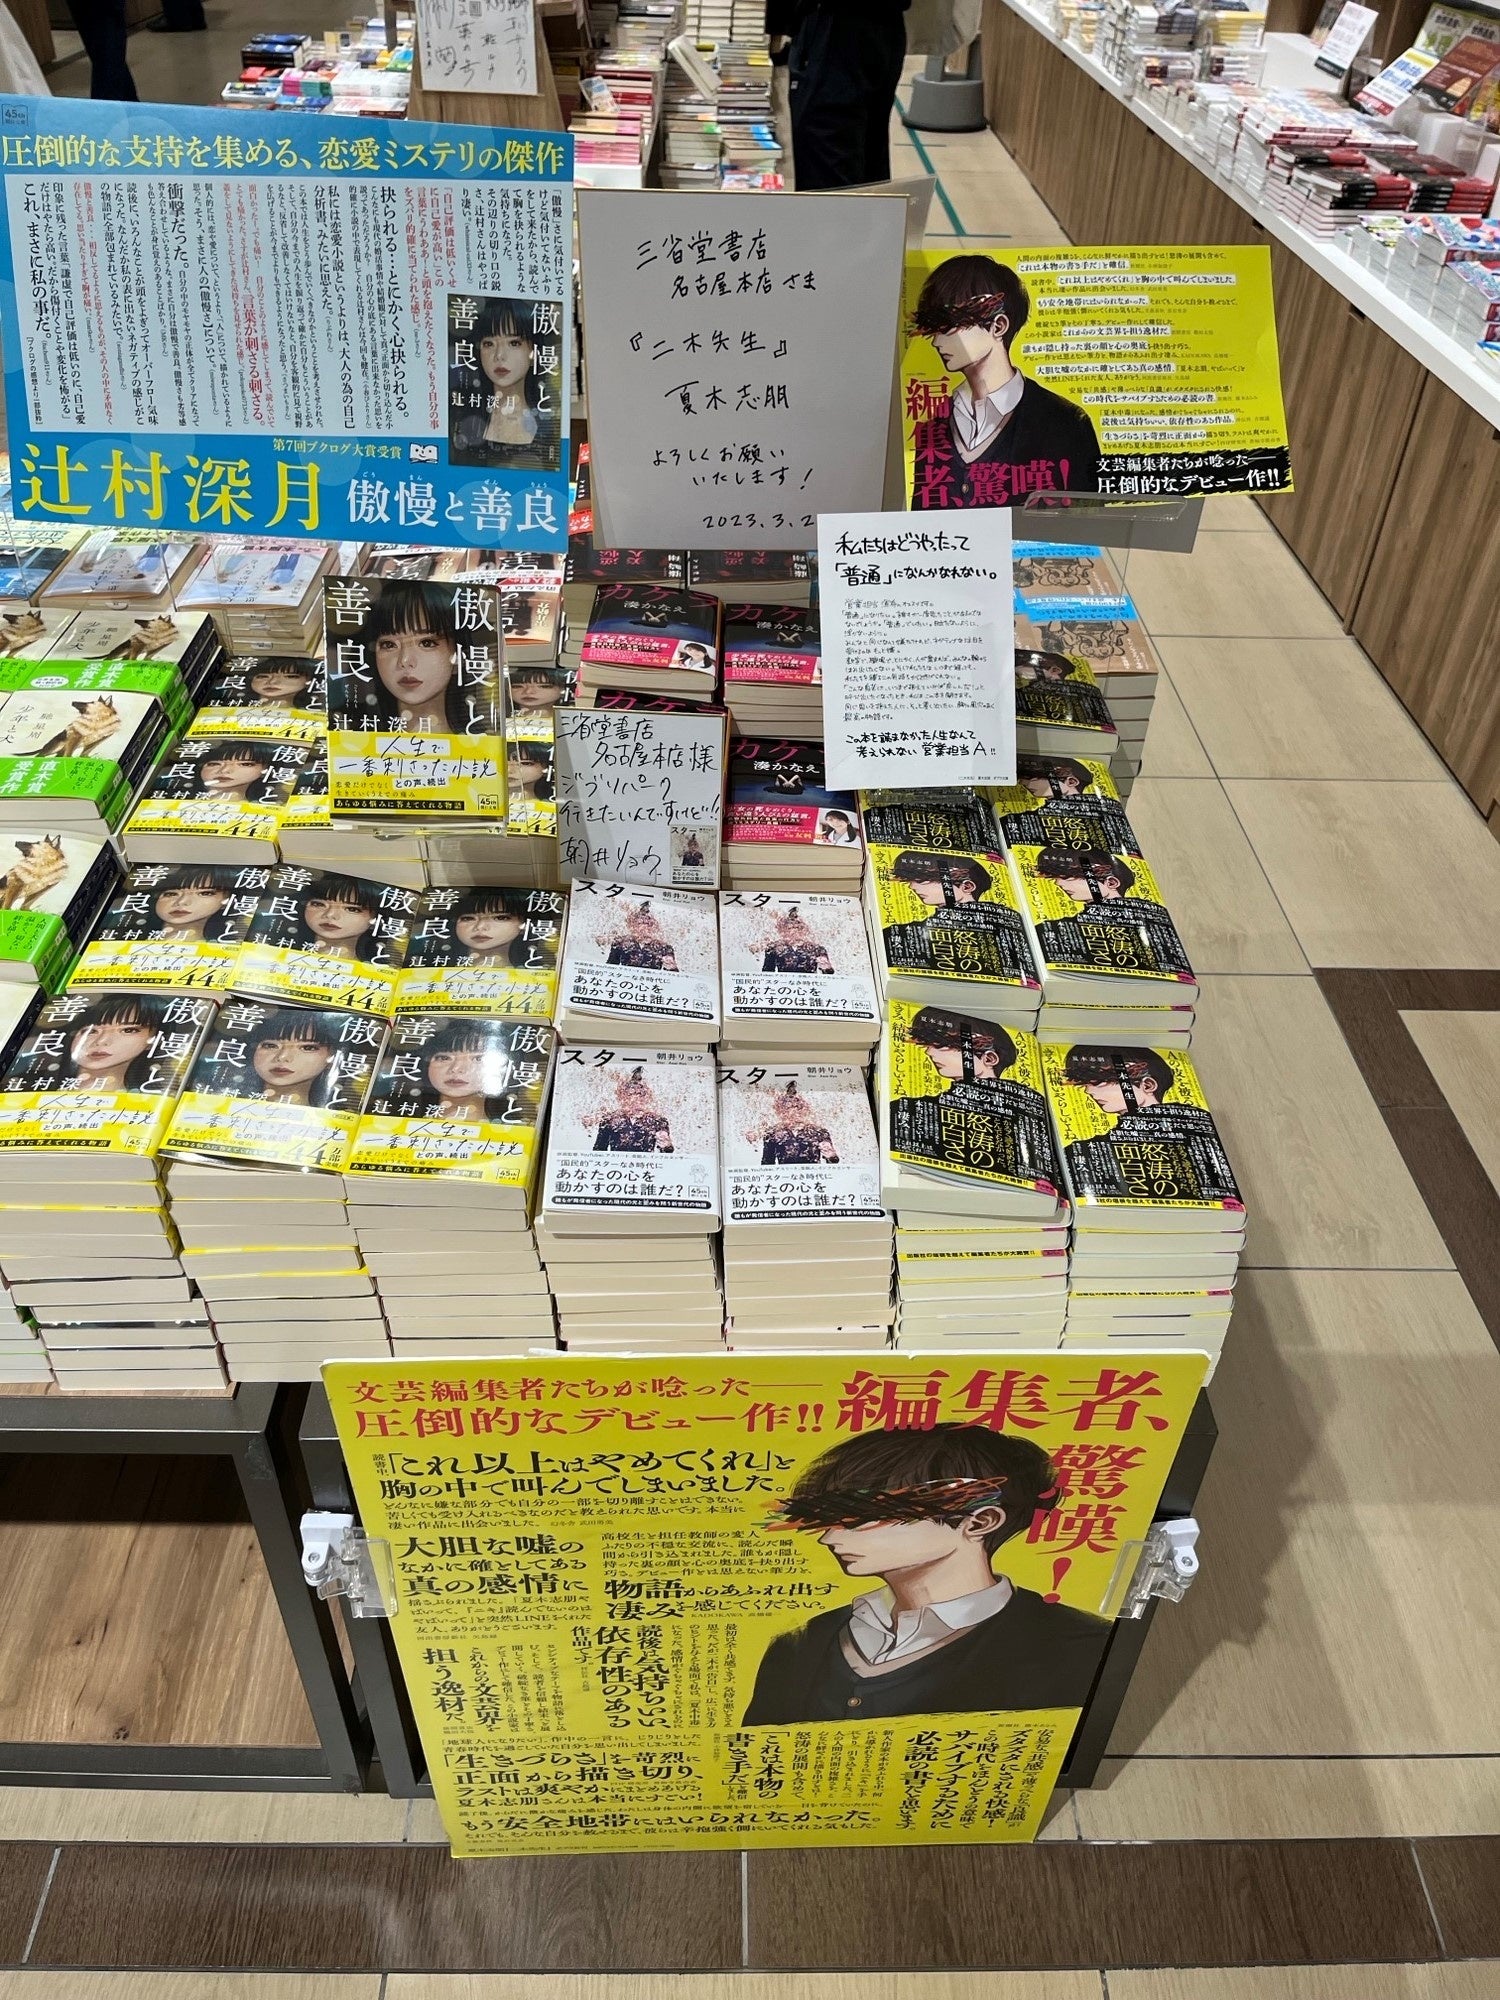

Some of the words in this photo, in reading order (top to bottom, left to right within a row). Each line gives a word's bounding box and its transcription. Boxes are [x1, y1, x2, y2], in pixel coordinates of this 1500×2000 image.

[2, 134, 565, 176] 圧倒的な支持を集める、恋愛ミステリの傑作
[430, 187, 444, 287] に自己愛が高い」この
[443, 187, 457, 288] 「自己評価は低いくせ
[500, 188, 513, 261] 気持ちになった。
[314, 185, 334, 315] 分析書、みたいに思えた。
[475, 188, 488, 290] さ、辻村さんはやっぱ
[487, 188, 501, 291] その辺りの切り口の鋭
[512, 189, 526, 294] て胸を抉られるような
[526, 189, 539, 294] をして来たから、読んで
[539, 189, 552, 295] けど気付いてないふり
[552, 189, 564, 295] 「傲慢」さに気付いてる
[636, 229, 769, 270] 三省堂書店
[24, 183, 52, 339] これ、まさに私の事だ。
[100, 182, 124, 341] の物語に全部包まれているみたいで。
[671, 267, 817, 299] 名古屋本店さま
[40, 182, 71, 420] だけはやたら高い。だから傷付くことや変化を怖がる」
[53, 182, 86, 424] 印象に残った言葉「謙虚で自己評価は低いのに、自己愛
[114, 182, 144, 425] になった。なんだか私の表に出ないネガティブの感じがこ
[126, 182, 159, 425] 読後に、いろんなことが頭をよぎってオーバーフロー気味
[328, 185, 355, 428] 私には恋愛小説というよりは、大人の為の自己
[449, 298, 479, 371] 善良
[630, 330, 788, 360] 『二木先生』
[529, 303, 560, 413] 傲慢と
[665, 381, 790, 415] 夏木志朋
[273, 438, 402, 460] 第7回ブクログ大賞受賞
[652, 443, 785, 466] よろしくお願い
[906, 376, 963, 508] 編集者、
[20, 443, 320, 531] 辻村深月
[347, 478, 559, 534] 傲慢と善良
[968, 459, 1072, 507] 驚嘆!
[834, 531, 971, 556] 私たちはどうやったって
[834, 563, 998, 586] 「普通」になんかなれない。
[623, 600, 688, 615] 湊かなえ
[326, 581, 373, 684] 善良
[755, 621, 818, 633] 湊かなえ
[74, 663, 104, 689] 受賞作
[99, 662, 127, 688] 直木賞
[217, 657, 258, 690] 善良
[450, 587, 496, 737] 傲慢と
[333, 713, 433, 732] 辻村深月
[557, 712, 654, 743] 三省堂書店
[381, 736, 444, 758] 人生で
[845, 730, 977, 744] この本を読まなかった人生なんて
[856, 744, 918, 758] 考えられない
[162, 743, 210, 779] 善良
[338, 756, 497, 780] 一番刺さった小説
[591, 741, 718, 773] 名古屋本店様
[753, 761, 821, 775] 湊かなえ
[0, 760, 34, 793] 受賞作
[24, 760, 61, 794] 直木賞
[258, 746, 309, 805] 傲慢と
[395, 778, 447, 789] との声、続出
[561, 773, 672, 800] ジブリパーク
[334, 800, 463, 809] あらゆる悩みに答えてくれる物語
[905, 811, 928, 847] 面白さ
[927, 812, 953, 849] 怒涛の
[1041, 815, 1070, 850] 面白さ
[1063, 816, 1092, 850] 怒涛の
[560, 836, 662, 876] 朝井リョウ
[575, 880, 654, 898] スター
[940, 868, 955, 897] 二木先生
[1083, 862, 1099, 893] 二木先生
[217, 867, 270, 944] 傲慢と
[662, 891, 705, 903] 朝井リョウ
[724, 892, 800, 906] スター
[808, 896, 852, 904] 朝井リョウ
[929, 929, 956, 971] 面白さ
[954, 930, 982, 972] 怒涛の
[1081, 925, 1113, 966] 面白さ
[1106, 925, 1138, 969] 怒涛の
[178, 969, 218, 988] 44
[573, 975, 664, 995] あなたの心を
[733, 985, 821, 997] あなたの心を
[339, 989, 373, 1010] 44
[572, 985, 689, 1008] 動かすのは誰だ?
[733, 995, 848, 1009] 動かすのは誰だ?
[561, 1050, 648, 1066] スター
[656, 1052, 703, 1062] 朝井リョウ
[3, 1077, 116, 1092] 辻村深月
[717, 1067, 799, 1085] スター
[371, 1101, 471, 1118] 辻村深月
[410, 1122, 472, 1137] 人生で
[364, 1136, 524, 1156] 一番刺さった小説
[555, 1181, 684, 1196] 動かすのは誰だ?
[556, 1168, 656, 1183] あなたの心を
[731, 1182, 827, 1195] あなたの心を
[732, 1193, 856, 1208] 動かすのは誰だ?
[835, 1369, 1170, 1434] 編集者、
[355, 1402, 825, 1439] 圧倒的なデビュー作!!
[372, 1453, 386, 1477] 読書中
[387, 1450, 796, 1477] 「これ以上はやめてくれ」と
[380, 1474, 785, 1500] 胸の中で叫んでしまいました。
[385, 1495, 744, 1509] どんなに嫌な部分でも自分の一部を切り離すことはできない。
[386, 1506, 747, 1519] 苦しくても受け入れるべきなのだと教えられた思いです。本当に
[387, 1518, 541, 1530] 凄い作品に出会いました。
[601, 1530, 760, 1541] 高校生と担任教師の変人
[1025, 1444, 1147, 1604] 驚嘆!
[396, 1534, 585, 1558] 大胆な嘘の
[601, 1539, 794, 1549] ふたりの不穏な交流に、読んだ瞬
[602, 1549, 803, 1559] 間から引き込まれました。誰もが隠し
[398, 1558, 587, 1573] なかに確としてある
[602, 1557, 809, 1567] 持った裏の顔と心の奥底を抉り出す
[604, 1567, 812, 1578] 巧さ。デビュー作とは思えない筆力と、
[402, 1573, 589, 1598] 真の感情に
[605, 1578, 840, 1600] 物語からあふれ出す
[408, 1598, 504, 1608] 揺さぶられました。
[606, 1600, 826, 1621] 凄みを感じてください。
[415, 1624, 557, 1634] 友人、ありがとうございます。
[571, 1626, 593, 1666] 作品です。
[423, 1647, 468, 1724] 担う逸材だ。
[469, 1647, 504, 1732] これからの文芸界を
[593, 1625, 633, 1728] 依存性のある
[633, 1624, 671, 1729] 読後は気持ちいい、
[442, 1741, 701, 1754] 青春時代を過ごしていた自分を思い出してしまいました。
[638, 1733, 701, 1742] じりじりとした
[443, 1751, 701, 1769] 「生きづらさ」を苛烈に
[722, 1732, 756, 1786] 書き手だ」
[754, 1732, 791, 1800] 「これは本物の
[452, 1766, 703, 1786] 正面から描き切り、
[896, 1729, 943, 1831] 必読の書だと思います。
[930, 1729, 979, 1829] サバイブするために
[960, 1729, 1000, 1829] この時代をほんとうの意味で
[982, 1729, 1034, 1828] ズタズタにされる快感!
[457, 1783, 701, 1798] ラストは爽やかにまとめあげる
[458, 1793, 702, 1808] 夏木志朋さんは本当にすごい!
[462, 1809, 881, 1832] もう安全地帯にはいられなかった。
